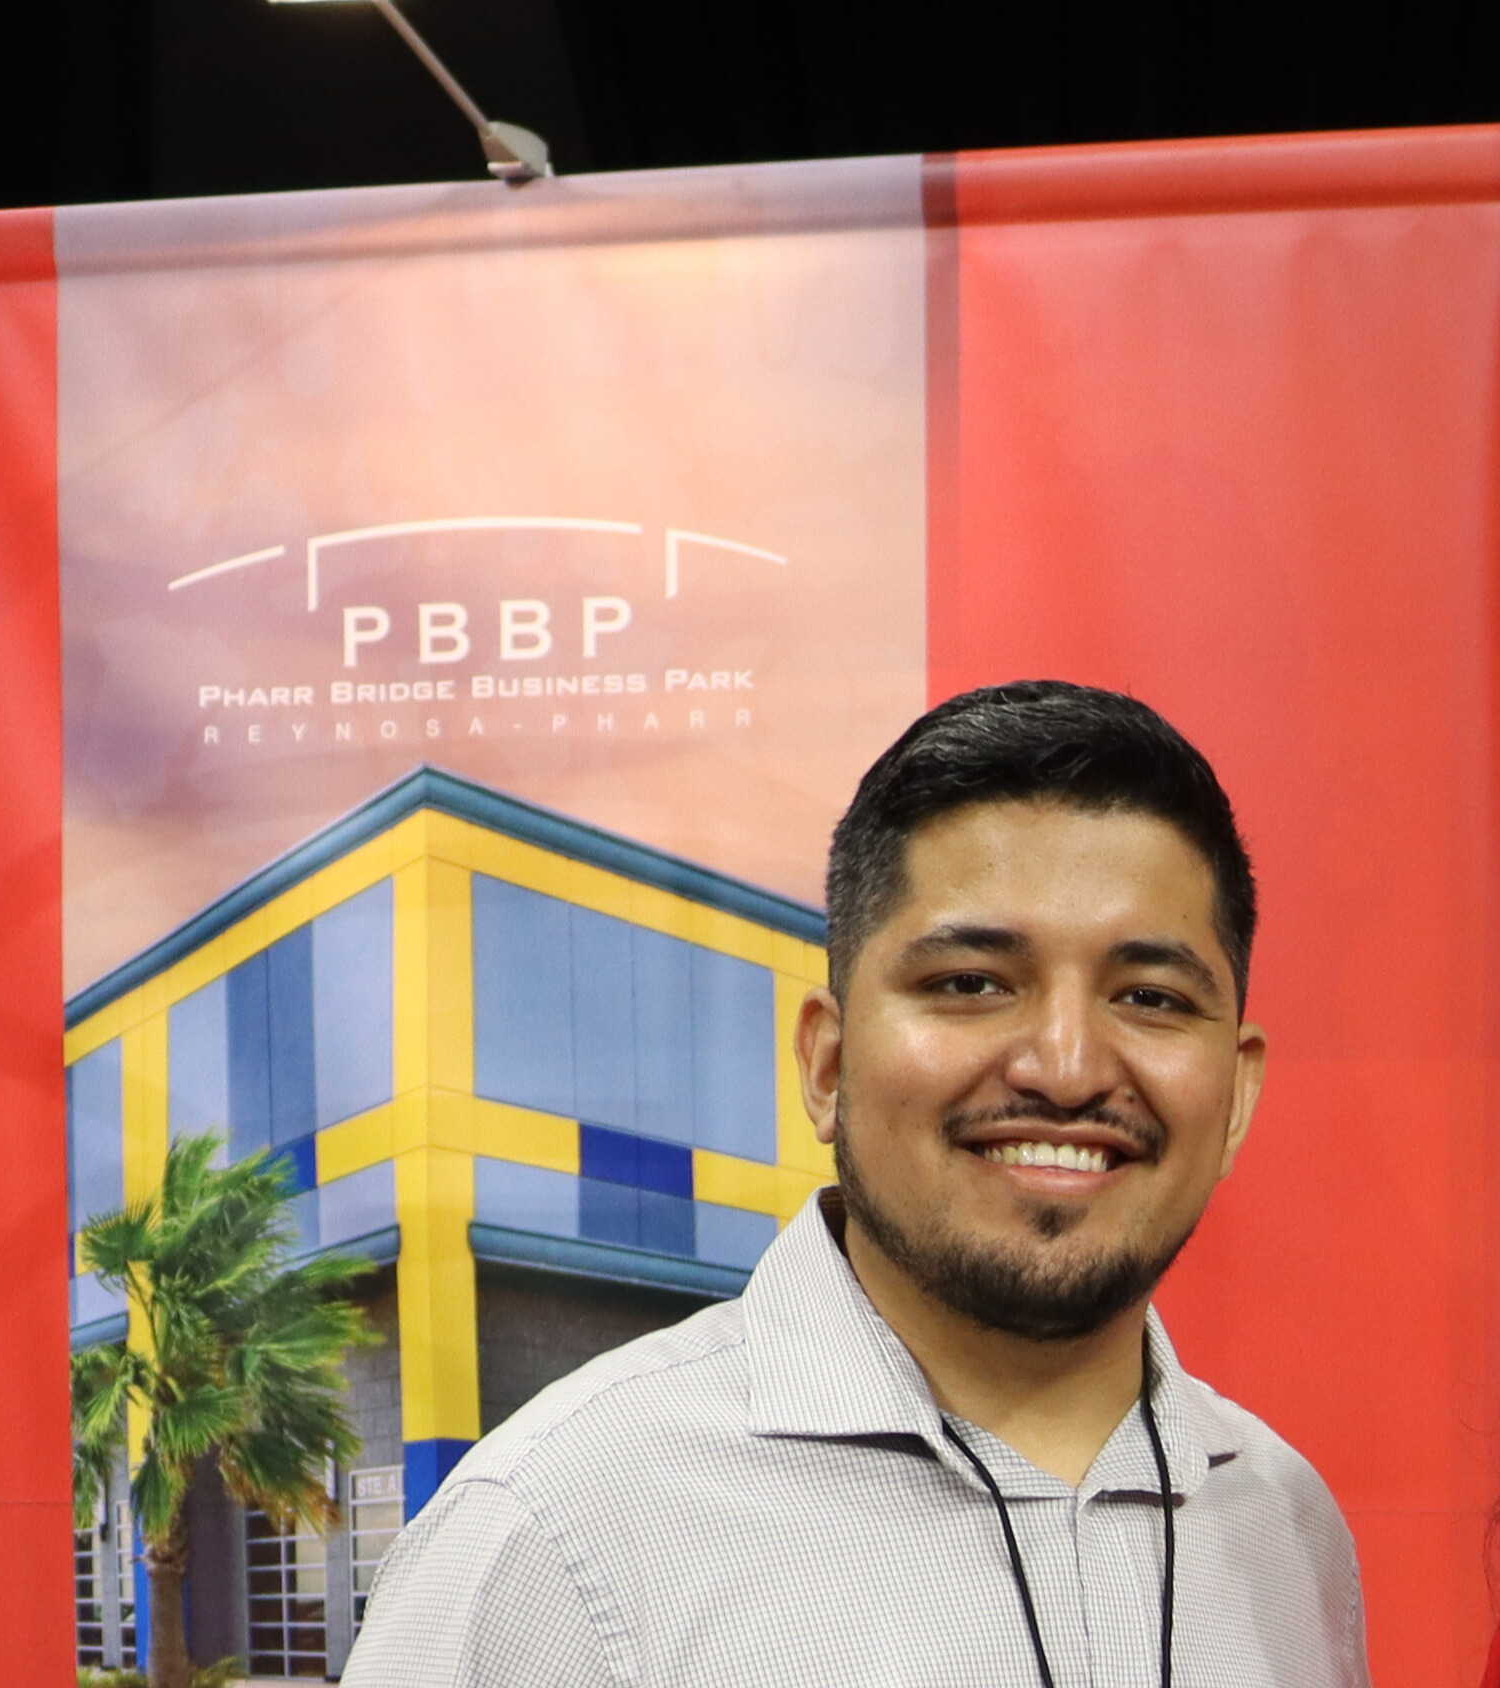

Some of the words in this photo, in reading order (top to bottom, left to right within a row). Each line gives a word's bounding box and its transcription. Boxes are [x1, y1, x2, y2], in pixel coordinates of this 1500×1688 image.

[343, 596, 631, 667] PBBP
[199, 683, 314, 708] PHARR
[331, 678, 456, 705] BRIDGE
[472, 672, 647, 699] BUSINESS
[665, 667, 755, 693] PARK
